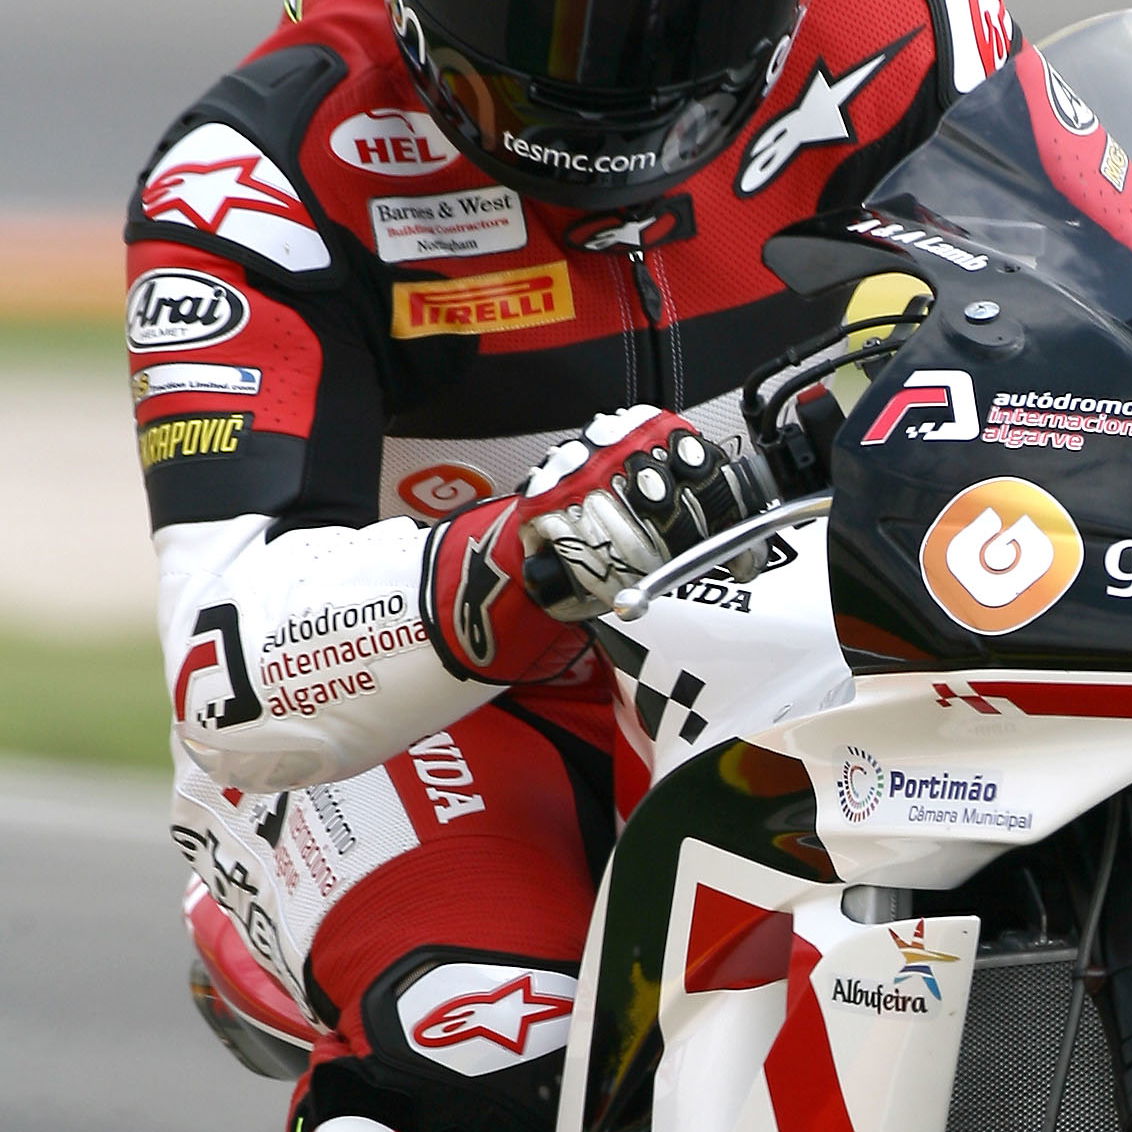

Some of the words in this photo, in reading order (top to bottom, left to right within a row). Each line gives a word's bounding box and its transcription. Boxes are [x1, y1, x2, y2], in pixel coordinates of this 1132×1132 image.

[355, 137, 448, 164] HEL
[503, 130, 656, 173] tesmc.com
[377, 204, 435, 222] Barnes
[438, 201, 453, 219] &
[458, 194, 513, 215] West
[914, 236, 989, 271] Lamb
[136, 280, 225, 328] Arai
[409, 276, 555, 327] PIRELLI
[982, 423, 1085, 451] algarve
[661, 582, 753, 614] NDA
[260, 620, 429, 686] internaciona
[268, 670, 376, 717] algarve
[408, 730, 486, 824] NDA
[889, 769, 998, 804] Portimão
[907, 803, 958, 825] Câmara
[962, 806, 1033, 832] Municipal
[832, 977, 929, 1016] Albufeira
